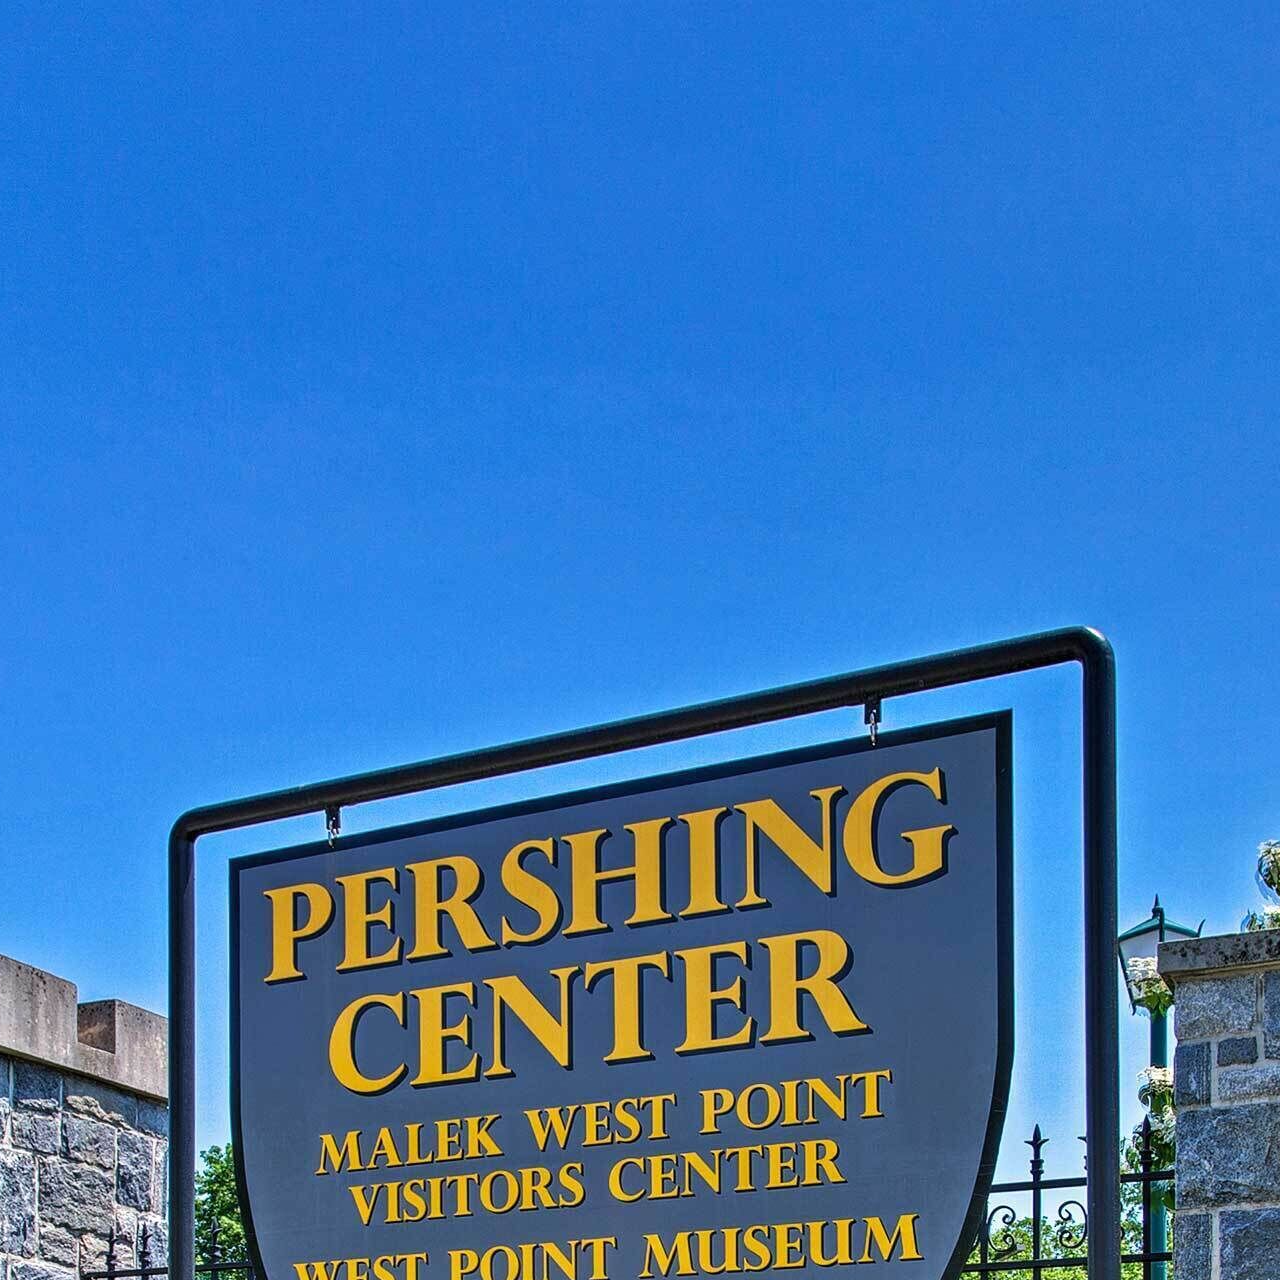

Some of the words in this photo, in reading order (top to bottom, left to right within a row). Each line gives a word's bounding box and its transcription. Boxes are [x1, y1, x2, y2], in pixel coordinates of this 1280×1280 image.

[263, 767, 952, 983] PERSHING
[328, 928, 868, 1095] CENTER
[316, 1114, 503, 1174] MALEK
[525, 1093, 676, 1150] WEST
[700, 1069, 892, 1134] POINT
[349, 1162, 585, 1224] VISITORS
[608, 1137, 845, 1202] CENTER
[640, 1213, 923, 1277] MUSEUM
